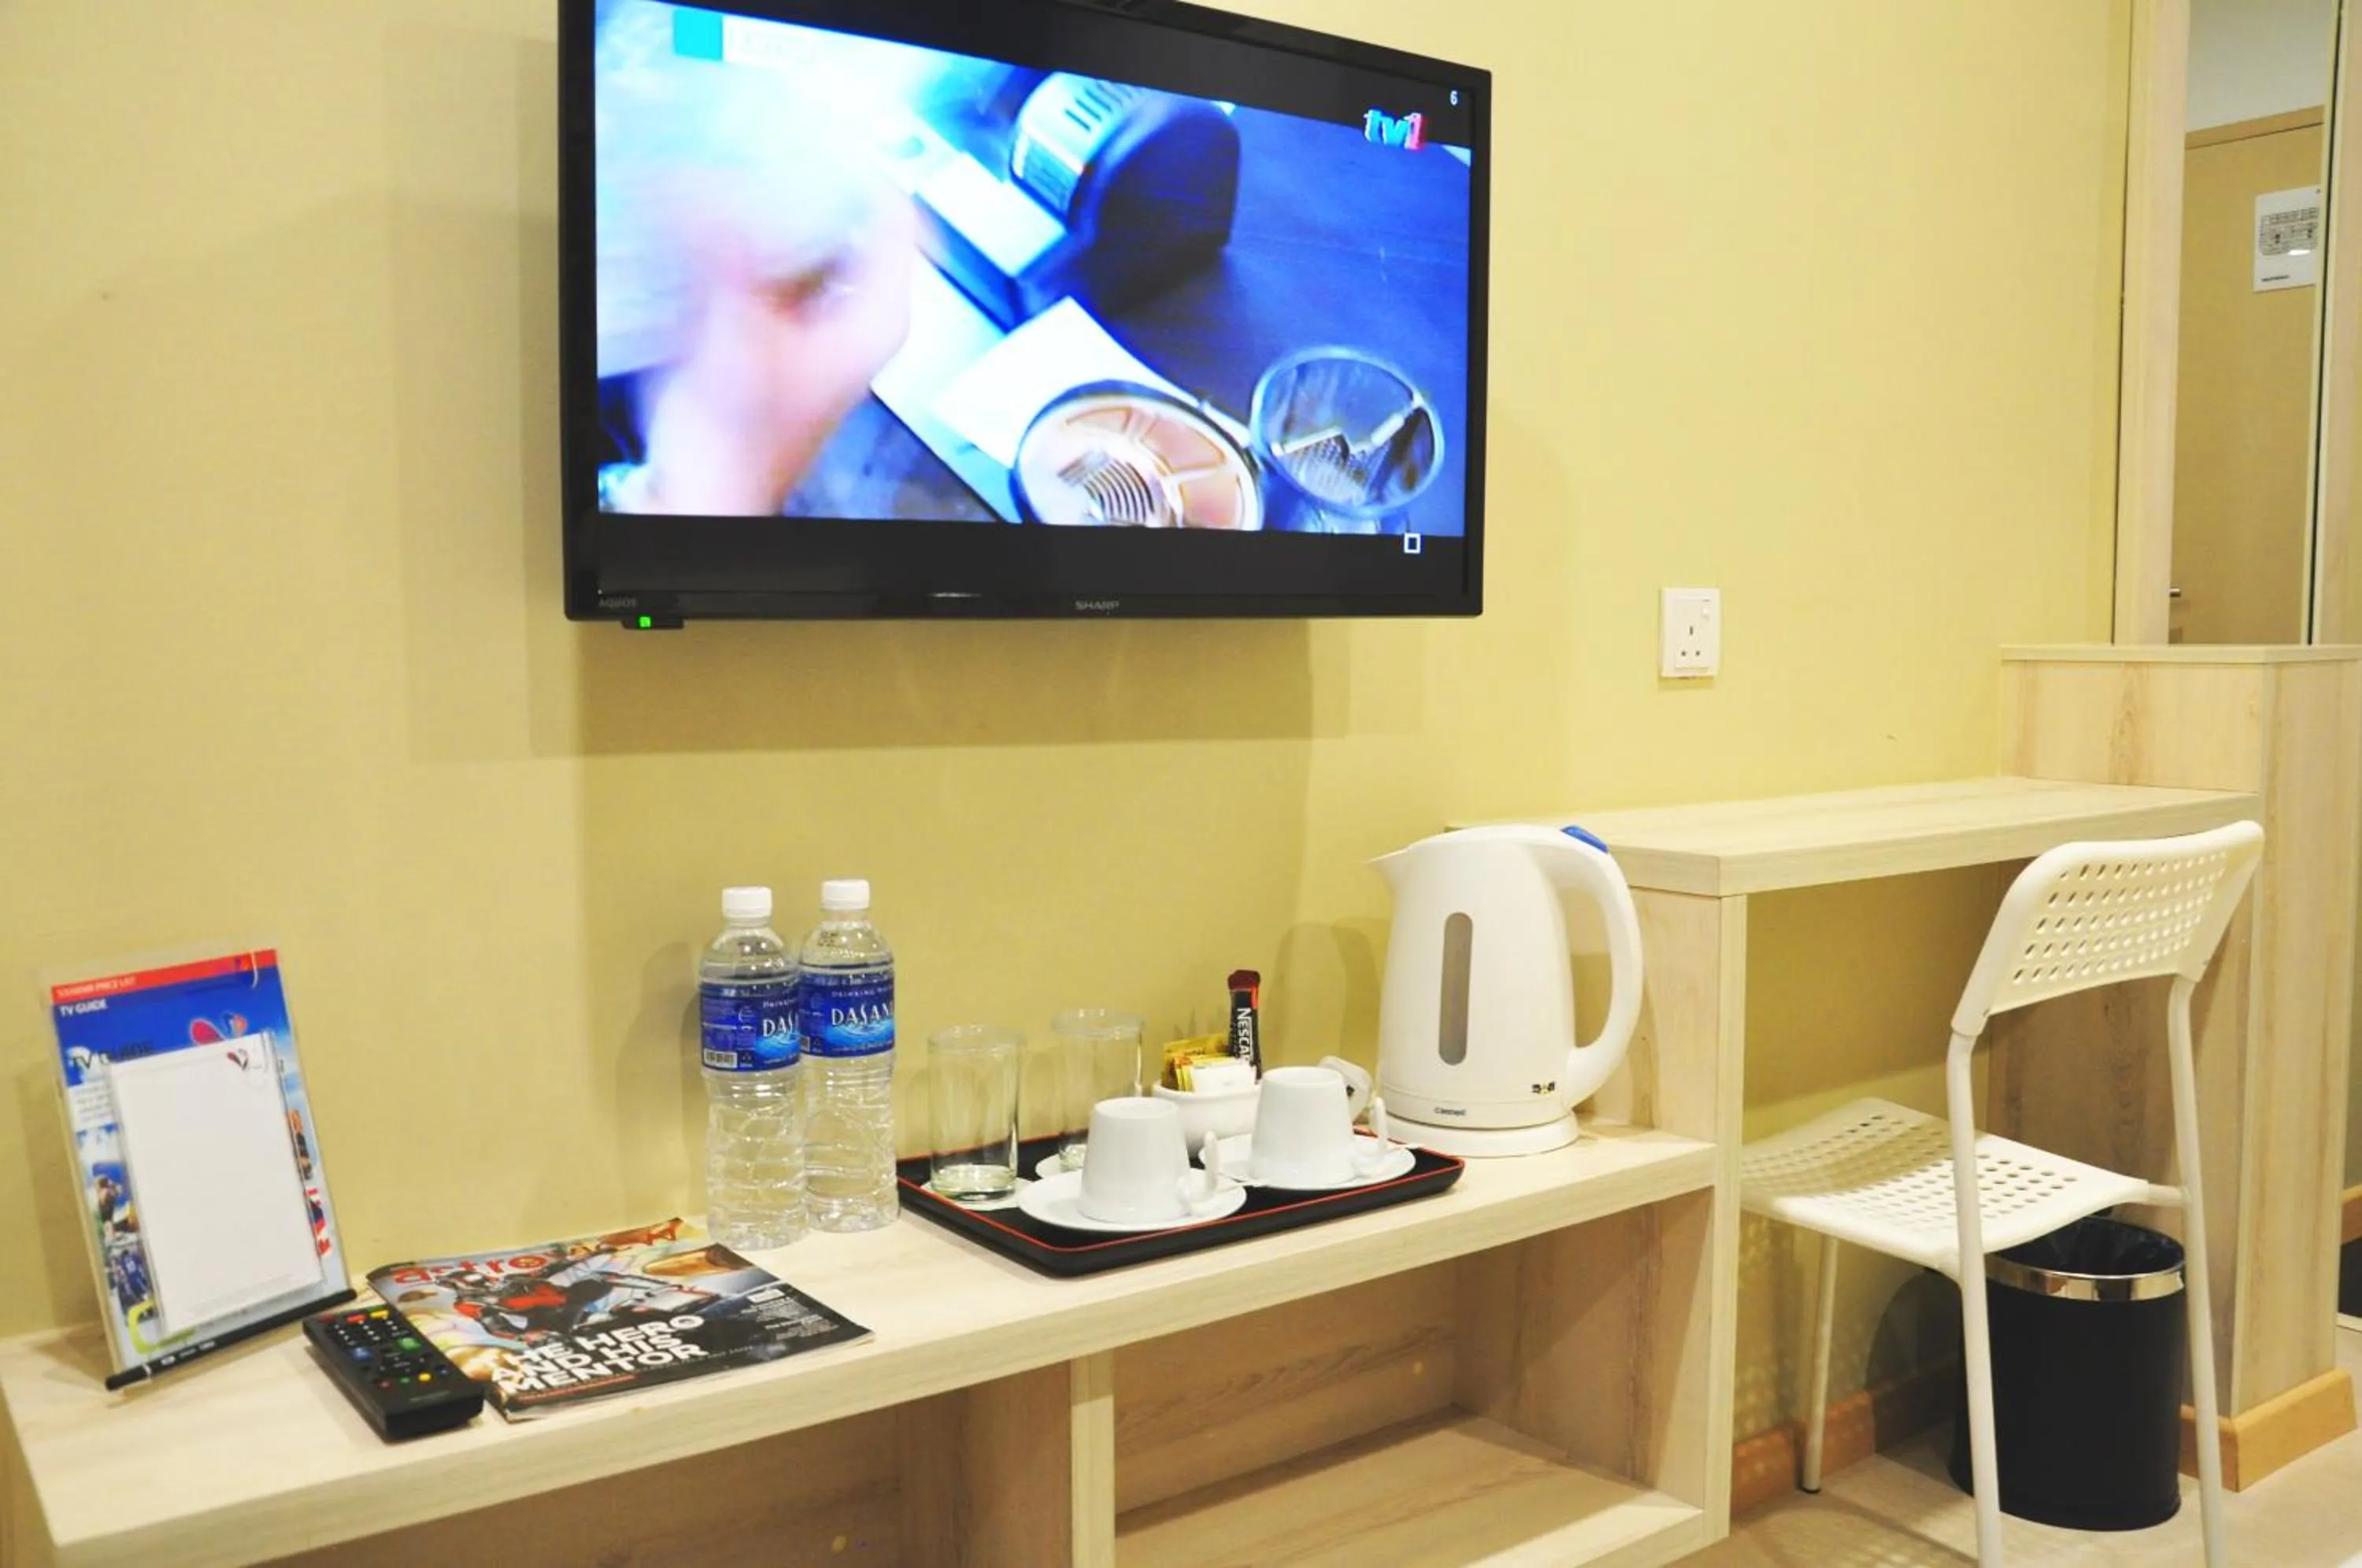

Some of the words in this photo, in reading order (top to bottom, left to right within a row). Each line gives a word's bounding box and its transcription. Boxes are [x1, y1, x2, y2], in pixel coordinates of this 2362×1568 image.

[1449, 90, 1458, 105] 6
[1074, 600, 1120, 610] SHARP
[60, 1004, 74, 1017] TV
[75, 997, 108, 1015] GUIDE
[831, 1002, 894, 1026] DASAN
[1236, 1008, 1253, 1061] NESCA
[576, 1315, 705, 1352] HERO
[491, 1352, 592, 1383] AND
[600, 1335, 684, 1360] HIS
[498, 1343, 709, 1395] MENTOR
